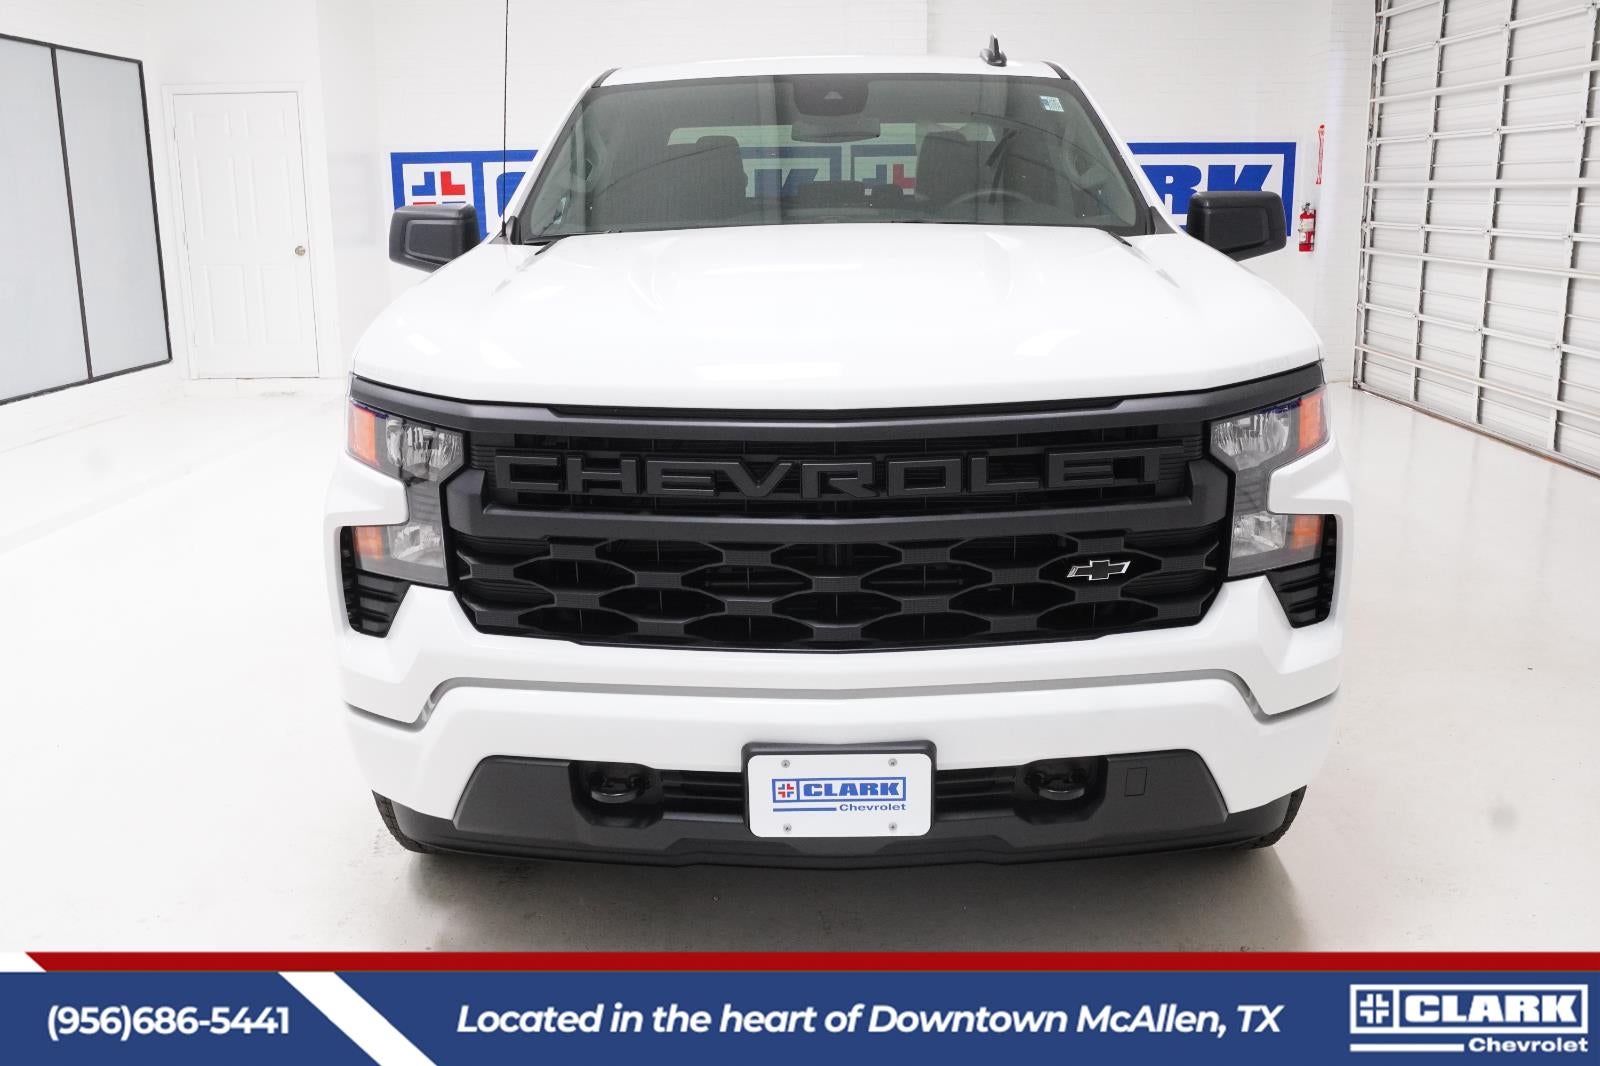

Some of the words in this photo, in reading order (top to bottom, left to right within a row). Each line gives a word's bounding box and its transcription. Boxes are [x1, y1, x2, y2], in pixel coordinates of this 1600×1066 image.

[494, 447, 1166, 501] CHEVROLET
[803, 782, 899, 797] CLARK
[839, 803, 906, 812] Chevrolet
